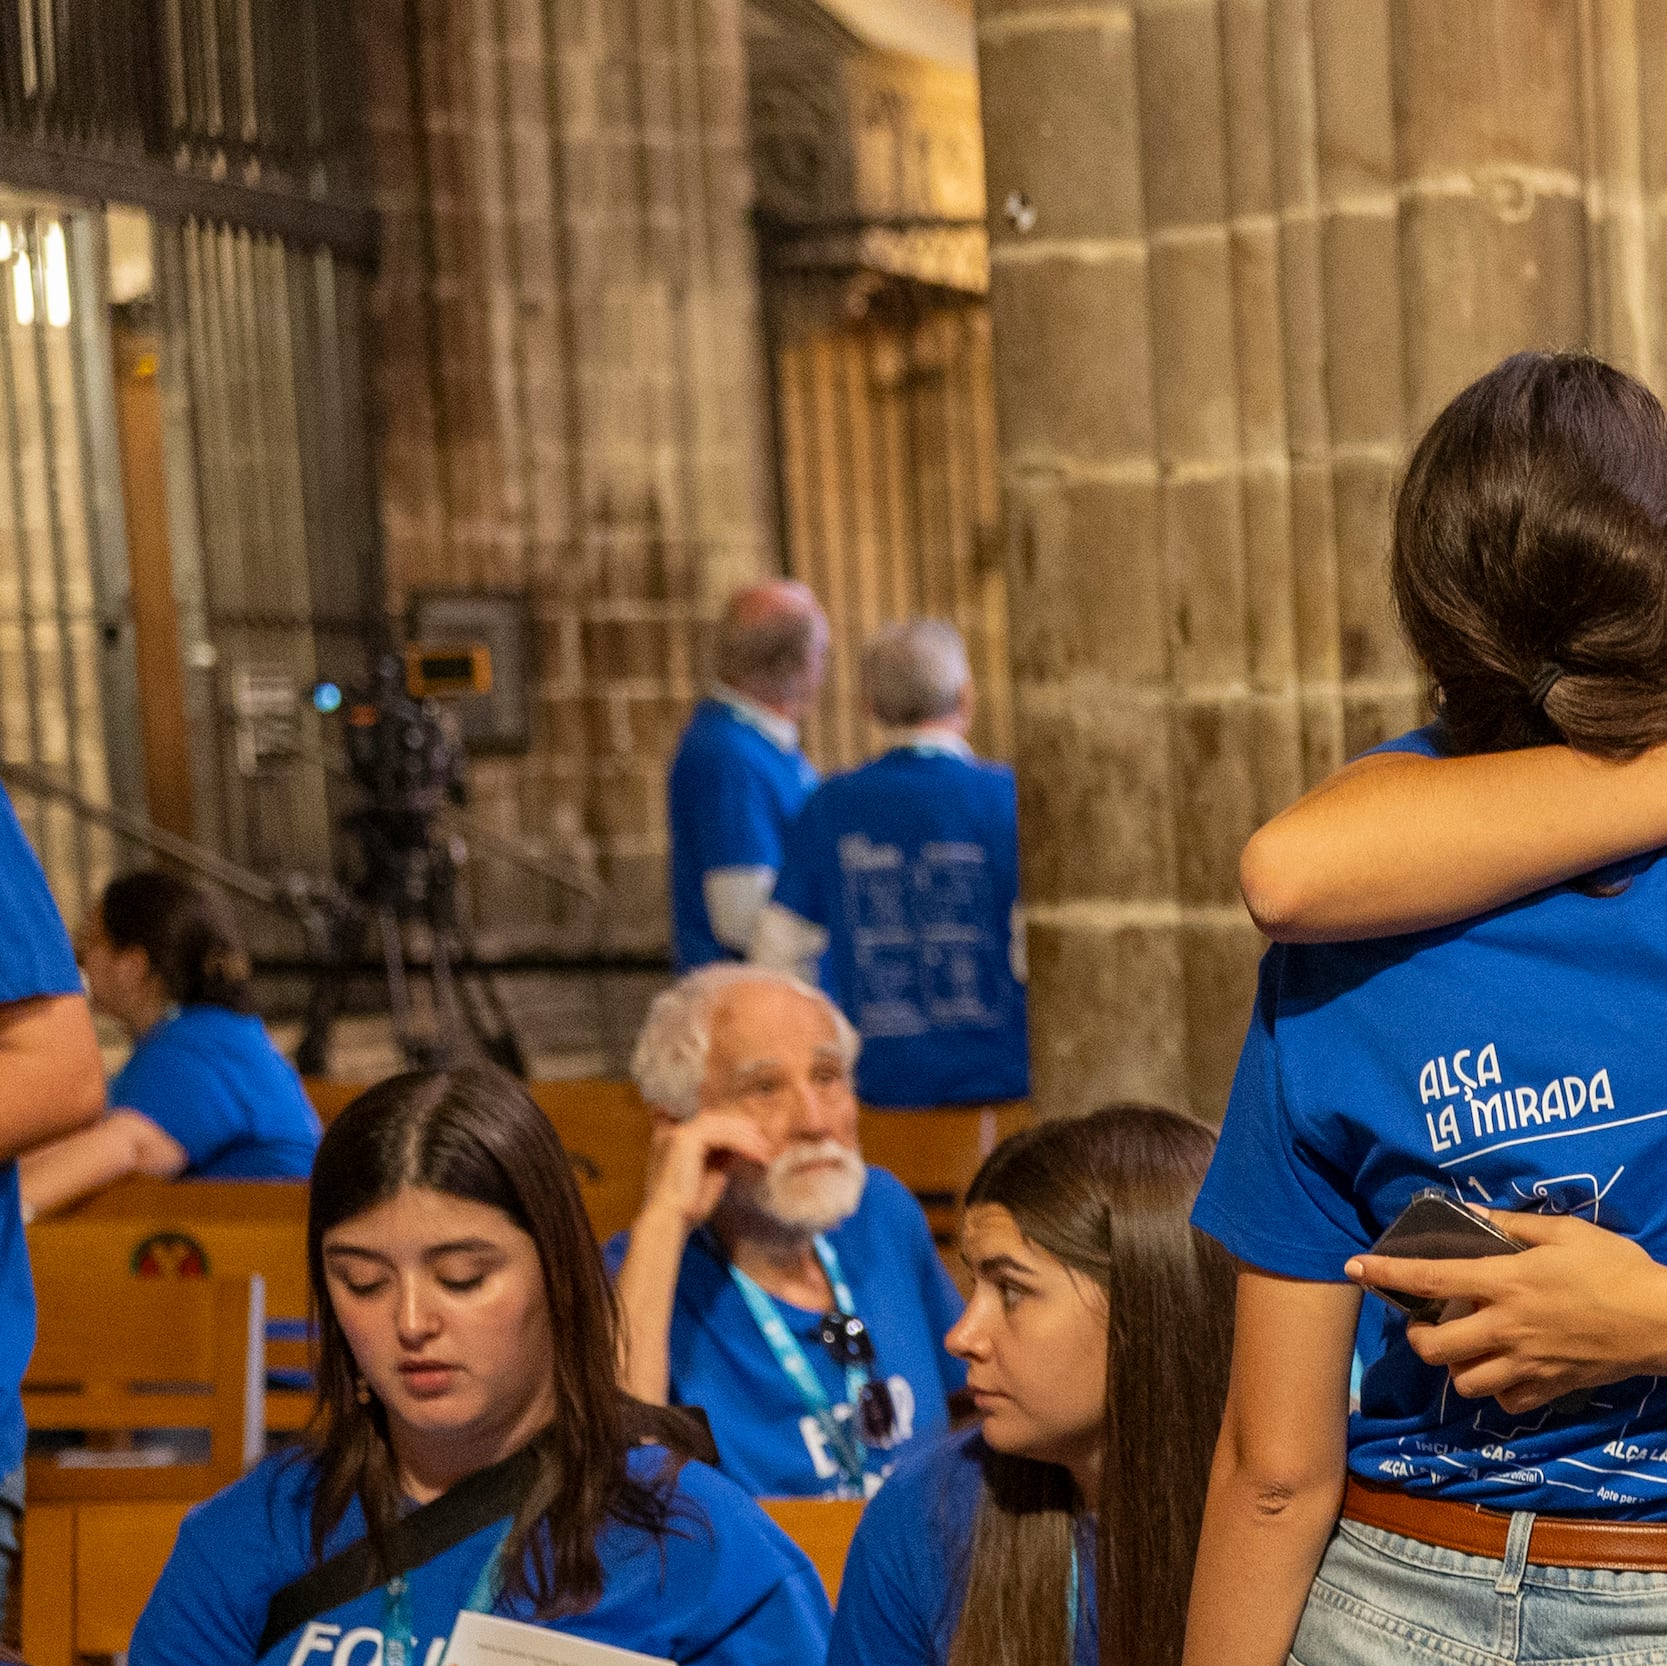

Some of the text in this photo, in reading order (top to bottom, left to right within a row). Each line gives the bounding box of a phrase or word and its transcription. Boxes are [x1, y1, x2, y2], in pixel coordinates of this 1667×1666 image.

[1419, 1043, 1502, 1103] ALÇA
[1425, 1068, 1615, 1152] LA MIRADA
[1468, 1175, 1493, 1203] 1
[1481, 1444, 1517, 1462] CAP
[1603, 1441, 1648, 1462] ALÇA
[1597, 1486, 1637, 1504] Apte per
